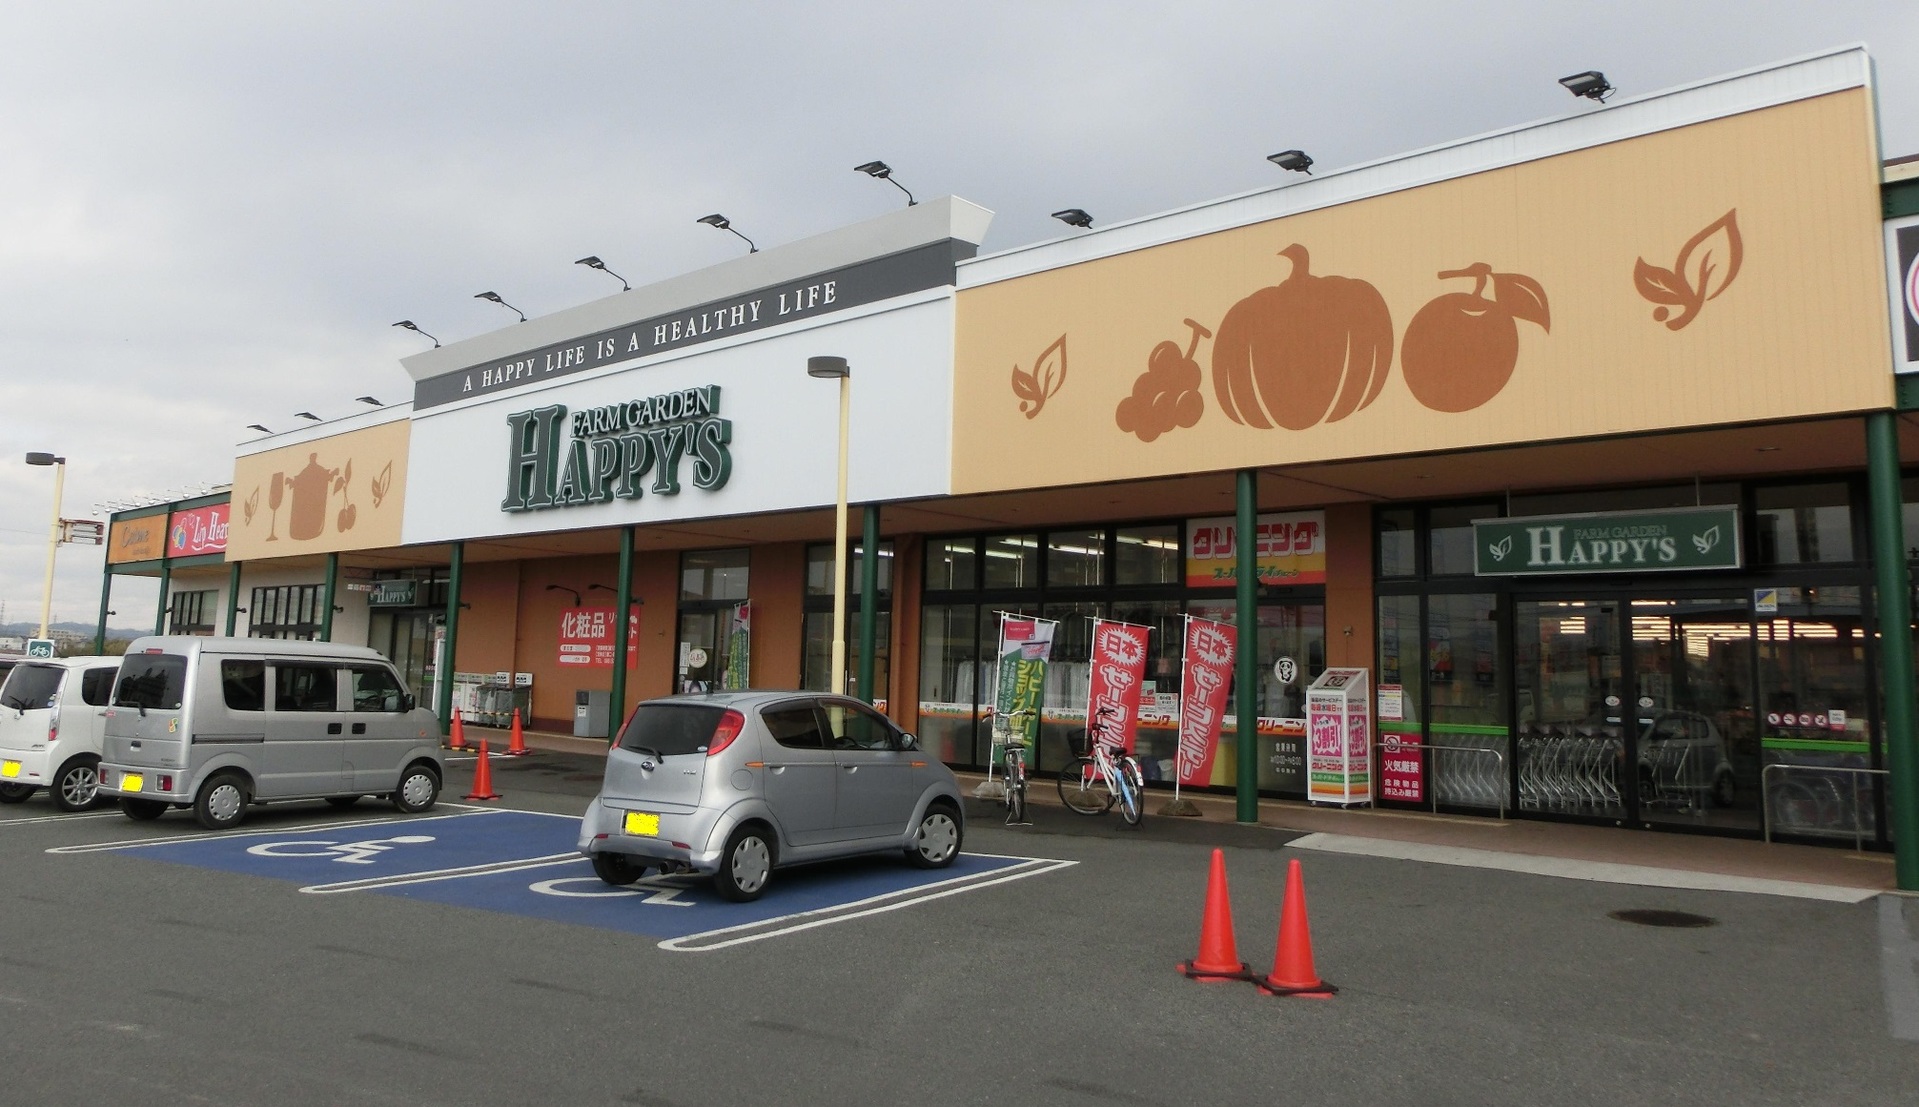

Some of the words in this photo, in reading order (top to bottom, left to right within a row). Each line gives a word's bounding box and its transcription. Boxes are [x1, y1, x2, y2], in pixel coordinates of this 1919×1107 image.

[463, 375, 473, 392] A
[481, 358, 535, 389] HAPPY
[545, 346, 585, 373] LIFE
[596, 338, 615, 360] IS
[627, 332, 640, 352] A
[654, 299, 762, 346] HEALTHY
[778, 281, 838, 316] LIFE
[571, 402, 630, 438] FARM
[625, 384, 721, 427] GARDEN
[501, 404, 732, 513] HAPPY'S
[1193, 521, 1319, 560] クリニング
[1526, 525, 1678, 566] HAPPY'S
[1573, 527, 1610, 539] FARM
[1611, 524, 1667, 538] GARDEN
[562, 612, 606, 639] 化粧品
[1257, 719, 1306, 733] クリーニン
[1384, 759, 1419, 774] 火気厳禁
